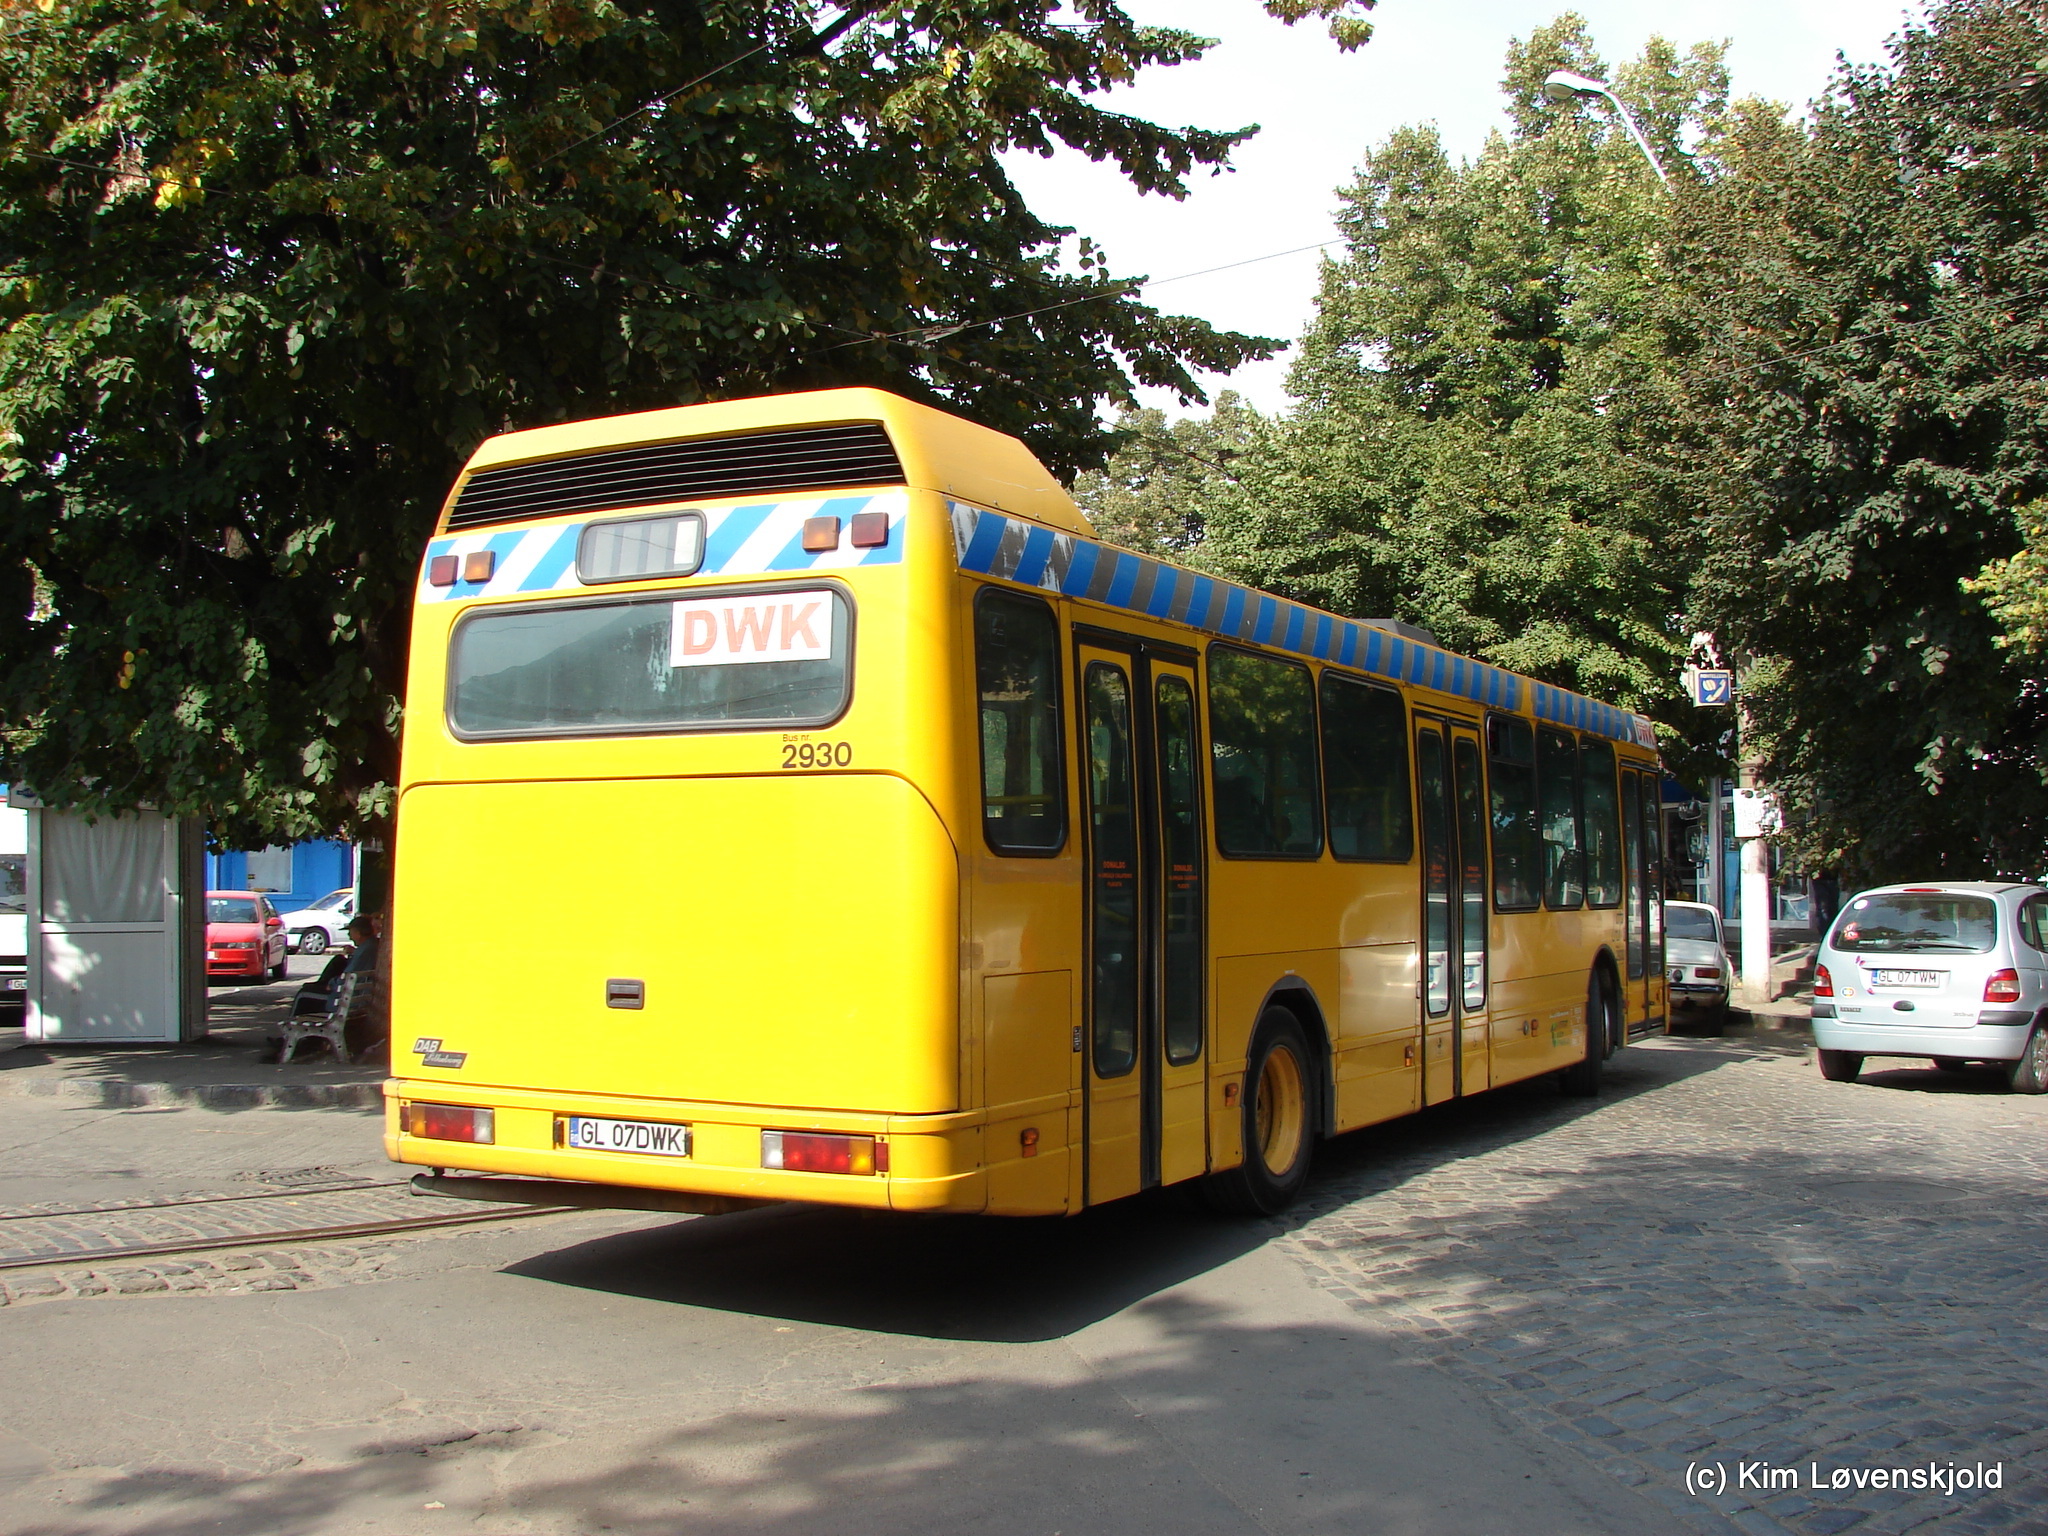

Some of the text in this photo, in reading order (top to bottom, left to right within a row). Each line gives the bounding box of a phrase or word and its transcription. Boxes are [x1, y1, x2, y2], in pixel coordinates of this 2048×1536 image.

[683, 602, 822, 655] DWK
[783, 734, 798, 742] Bus
[782, 742, 852, 768] 2930
[1878, 971, 1937, 983] GL 07TWM
[414, 1039, 440, 1052] DAB
[581, 1121, 605, 1145] GL
[613, 1124, 682, 1152] 07DWK
